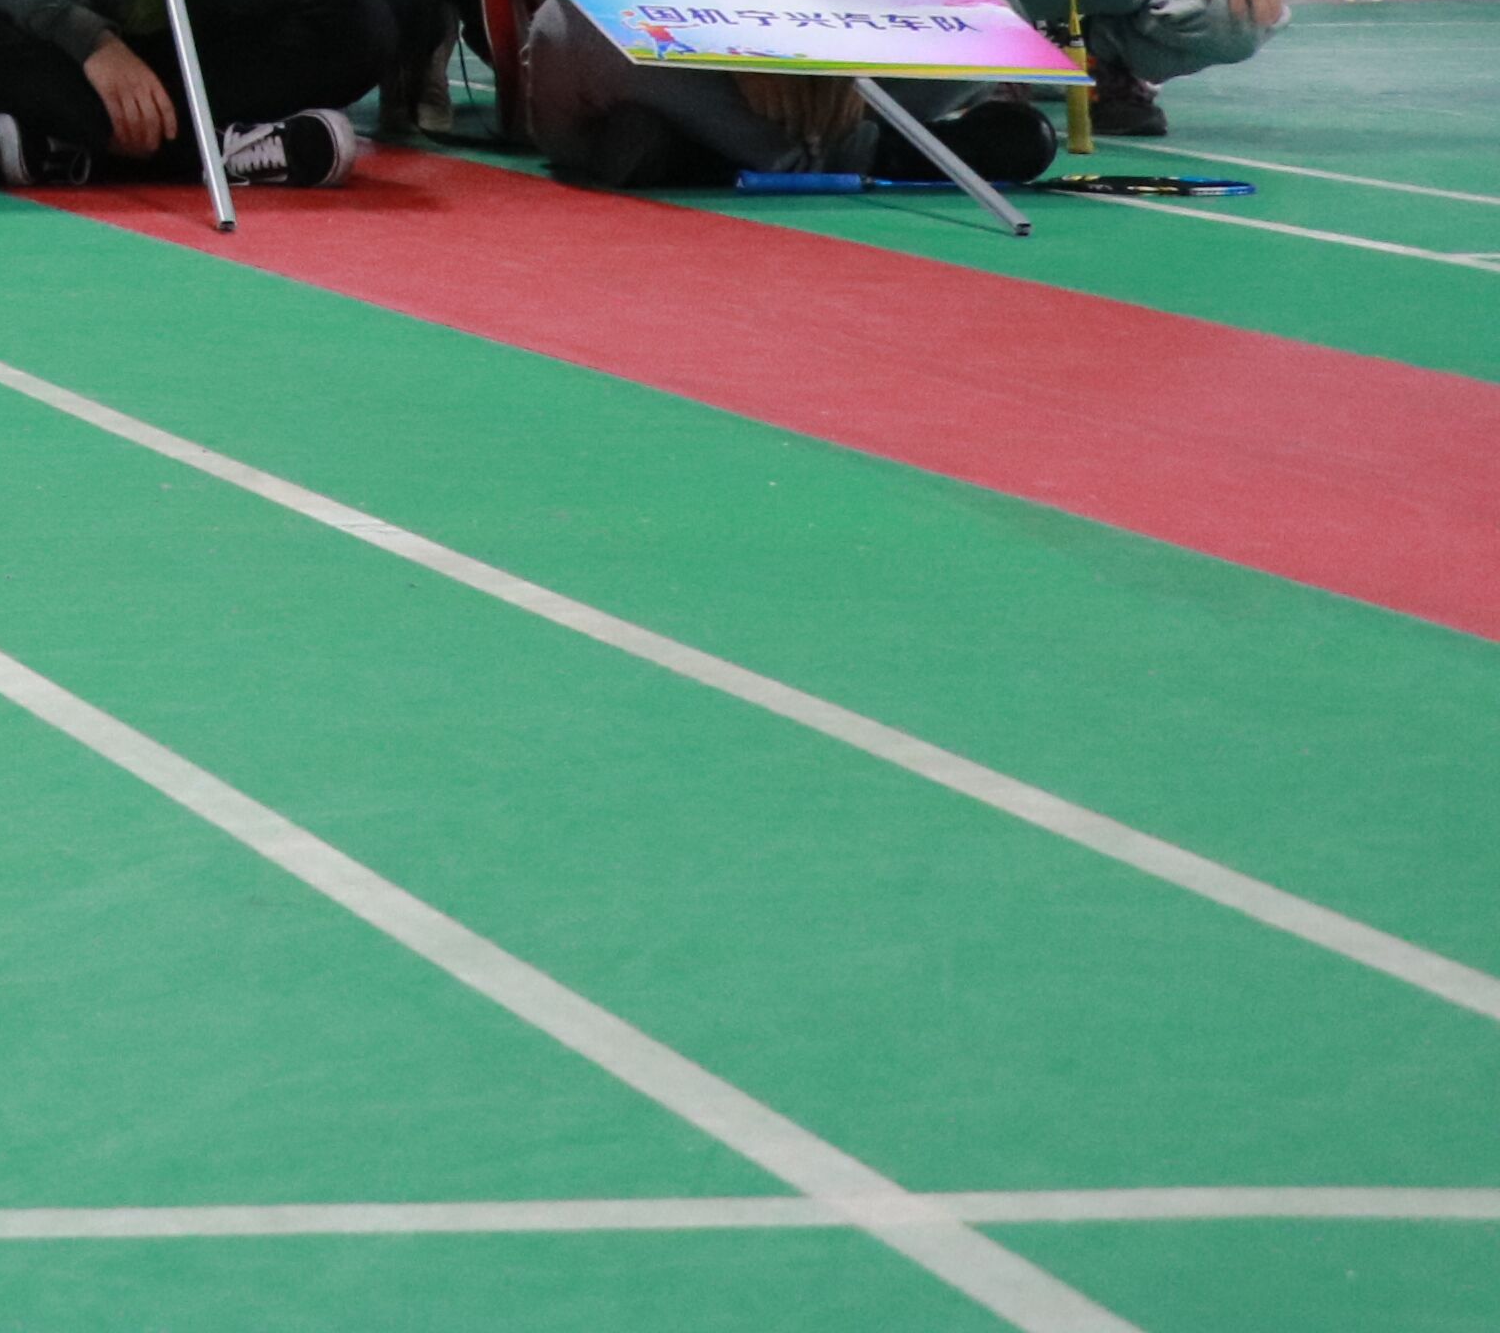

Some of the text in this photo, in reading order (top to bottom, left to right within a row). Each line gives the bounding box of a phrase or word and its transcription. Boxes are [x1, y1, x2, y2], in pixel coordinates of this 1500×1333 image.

[637, 4, 982, 33] 国机宁兴汽车队
